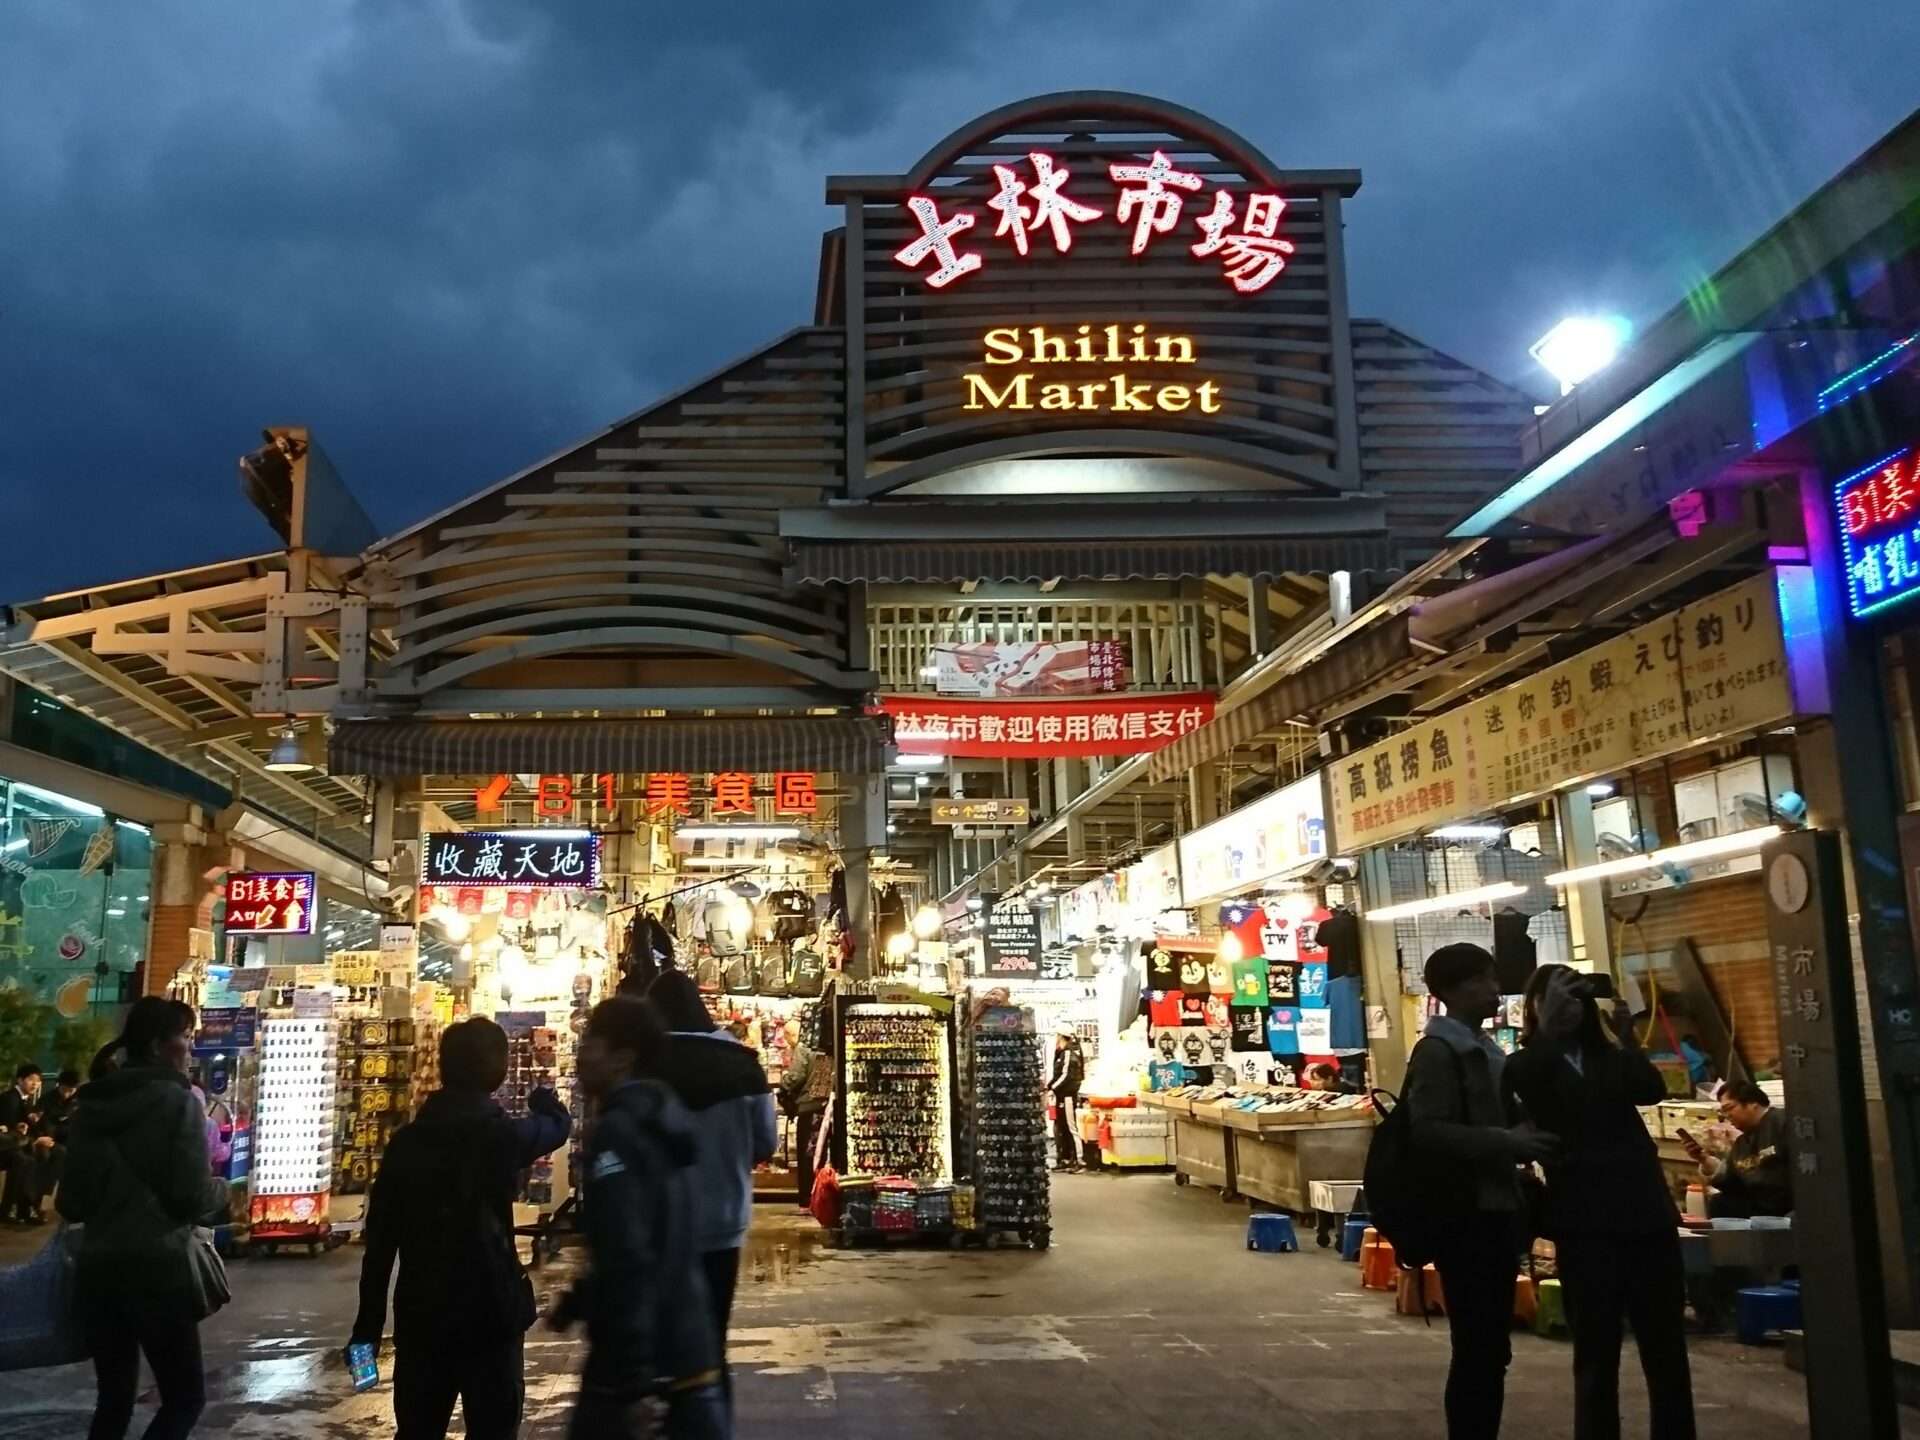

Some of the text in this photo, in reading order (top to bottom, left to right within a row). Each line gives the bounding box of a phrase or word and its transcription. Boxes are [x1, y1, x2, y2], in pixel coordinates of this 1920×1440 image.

[894, 150, 1295, 292] 士林市場
[982, 323, 1196, 365] Shilin
[962, 372, 1222, 414] Market
[1485, 657, 1614, 735] 迷你釣蝦
[1347, 728, 1454, 803] 高級撈魚
[538, 772, 817, 817] B1美食區
[435, 842, 584, 880] 收藏天地
[228, 910, 256, 922] 入口
[1265, 934, 1289, 945] TW
[1792, 948, 1823, 1023] 市場
